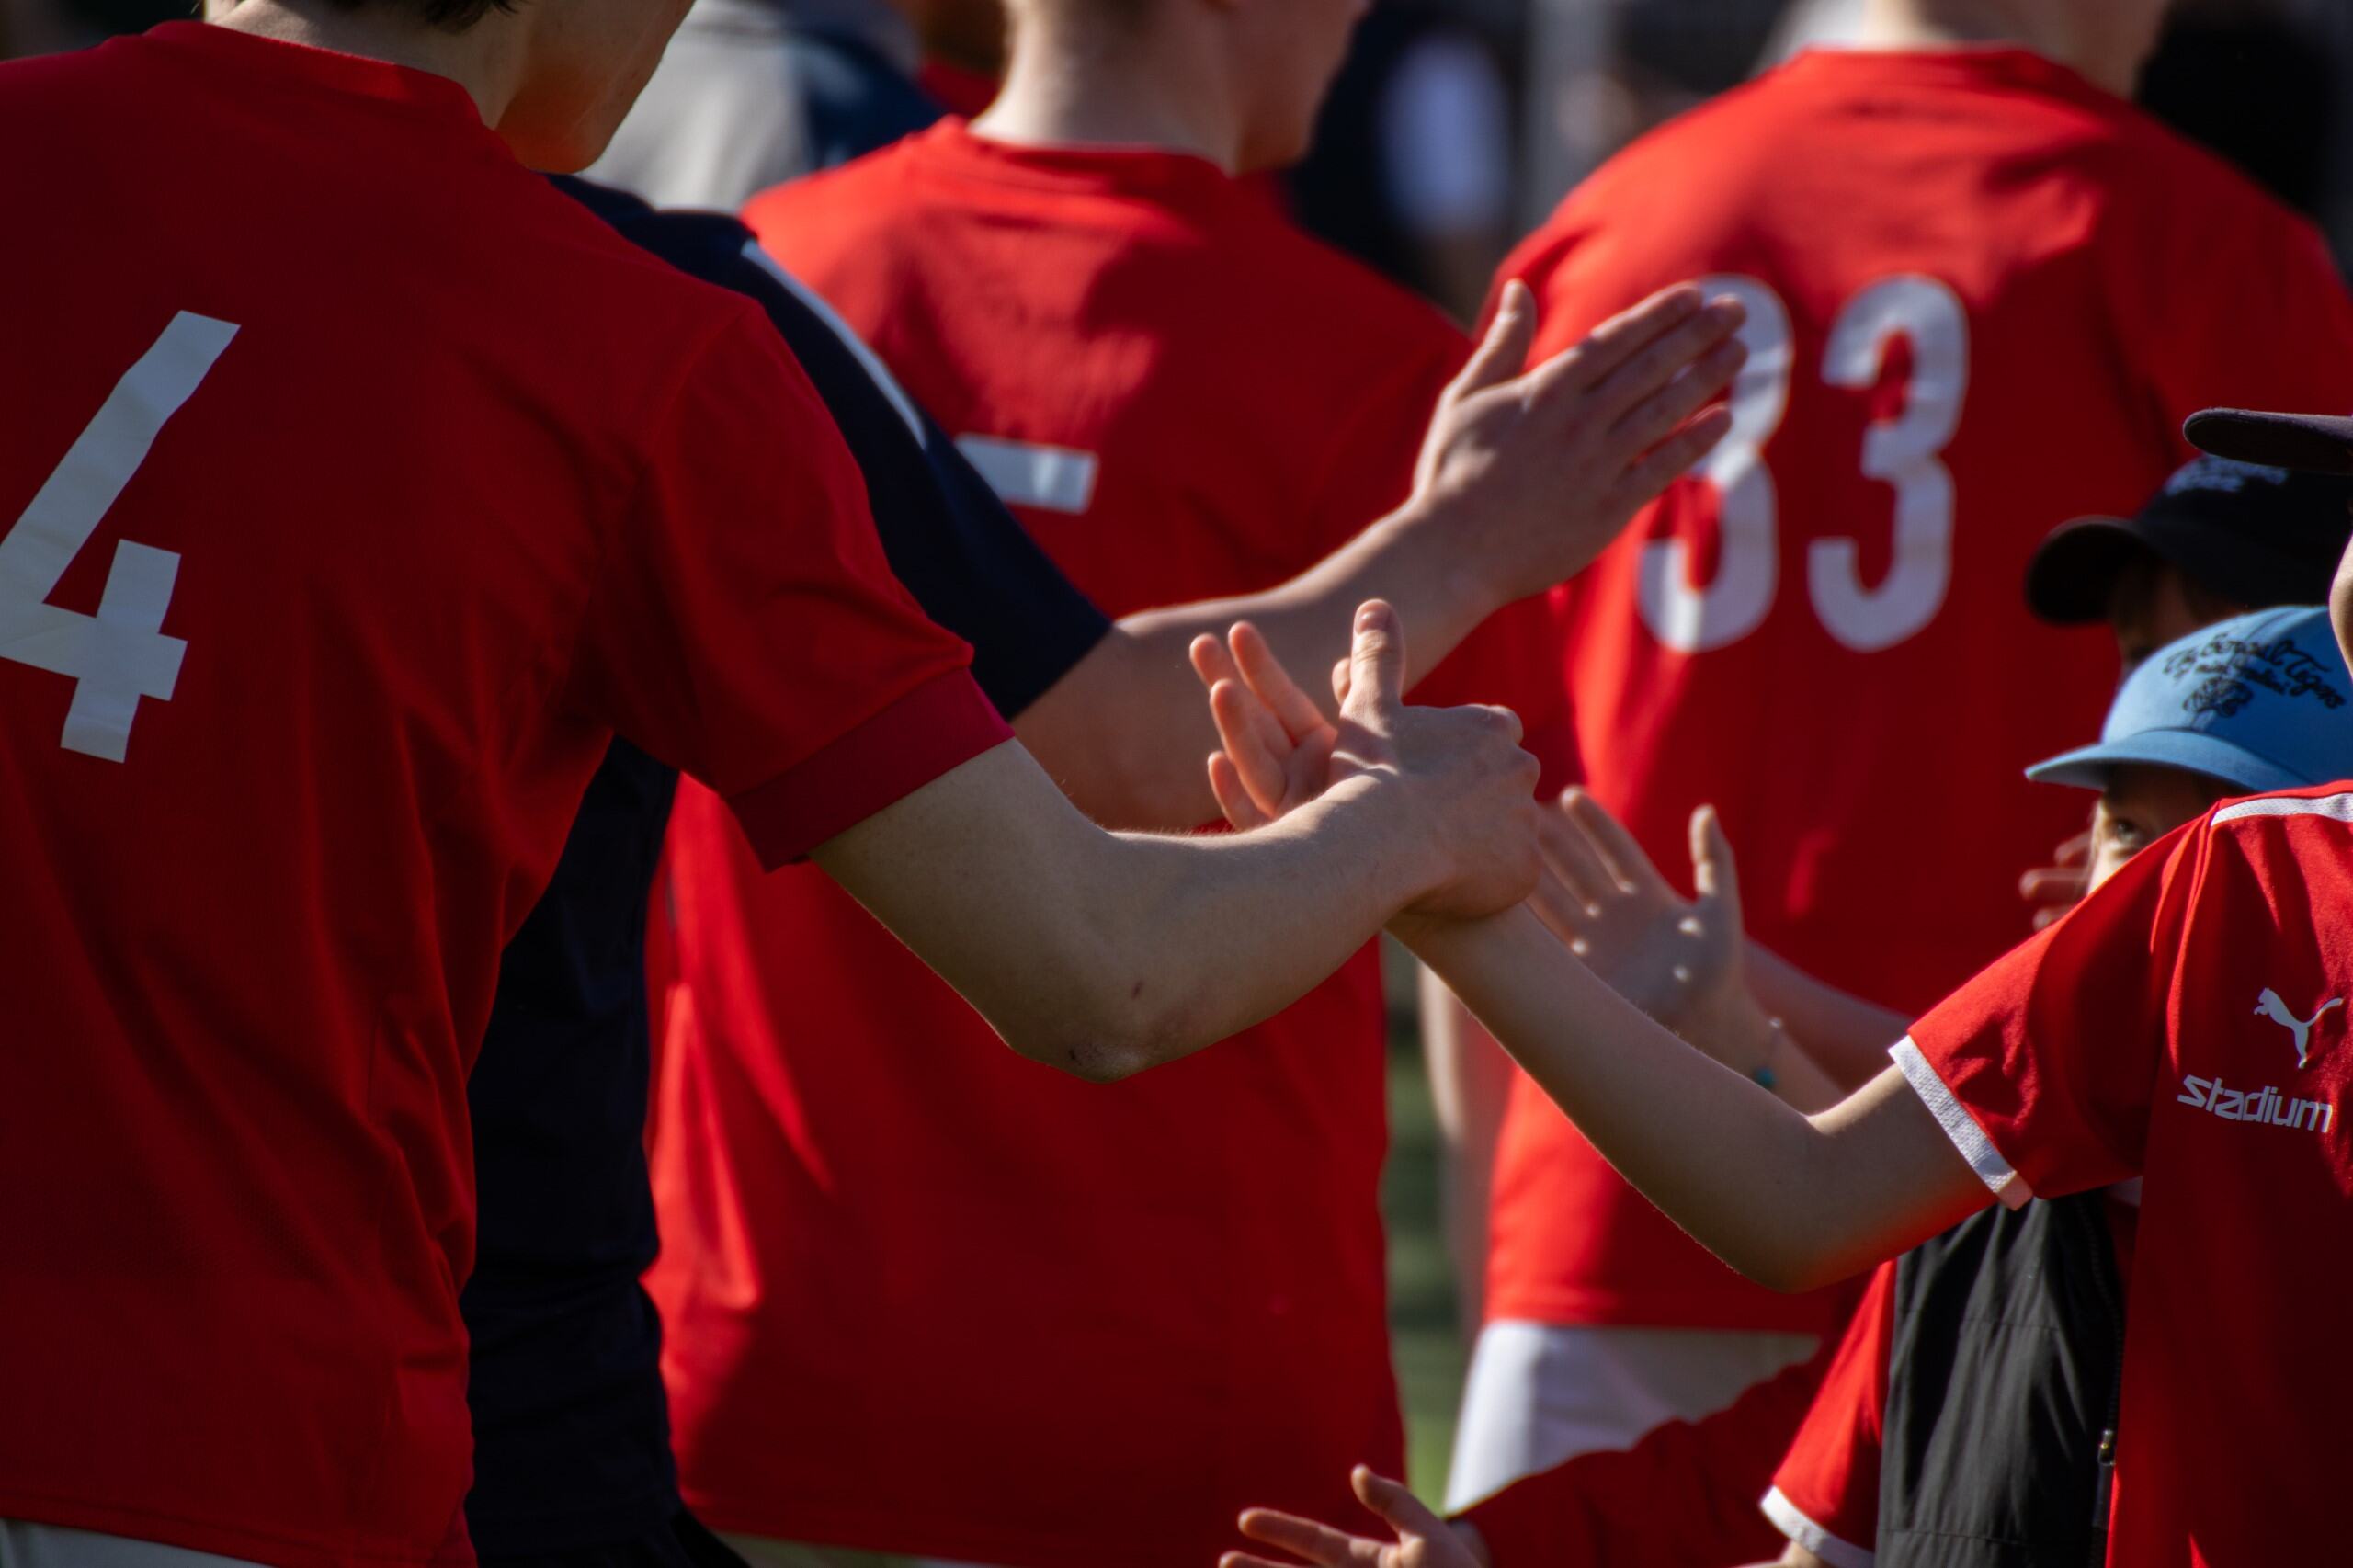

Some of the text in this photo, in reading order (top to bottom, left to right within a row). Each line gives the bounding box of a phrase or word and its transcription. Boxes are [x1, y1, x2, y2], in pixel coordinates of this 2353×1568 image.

[0, 311, 241, 763] 4
[1636, 273, 1971, 653] 33
[2177, 1074, 2333, 1133] stadium
